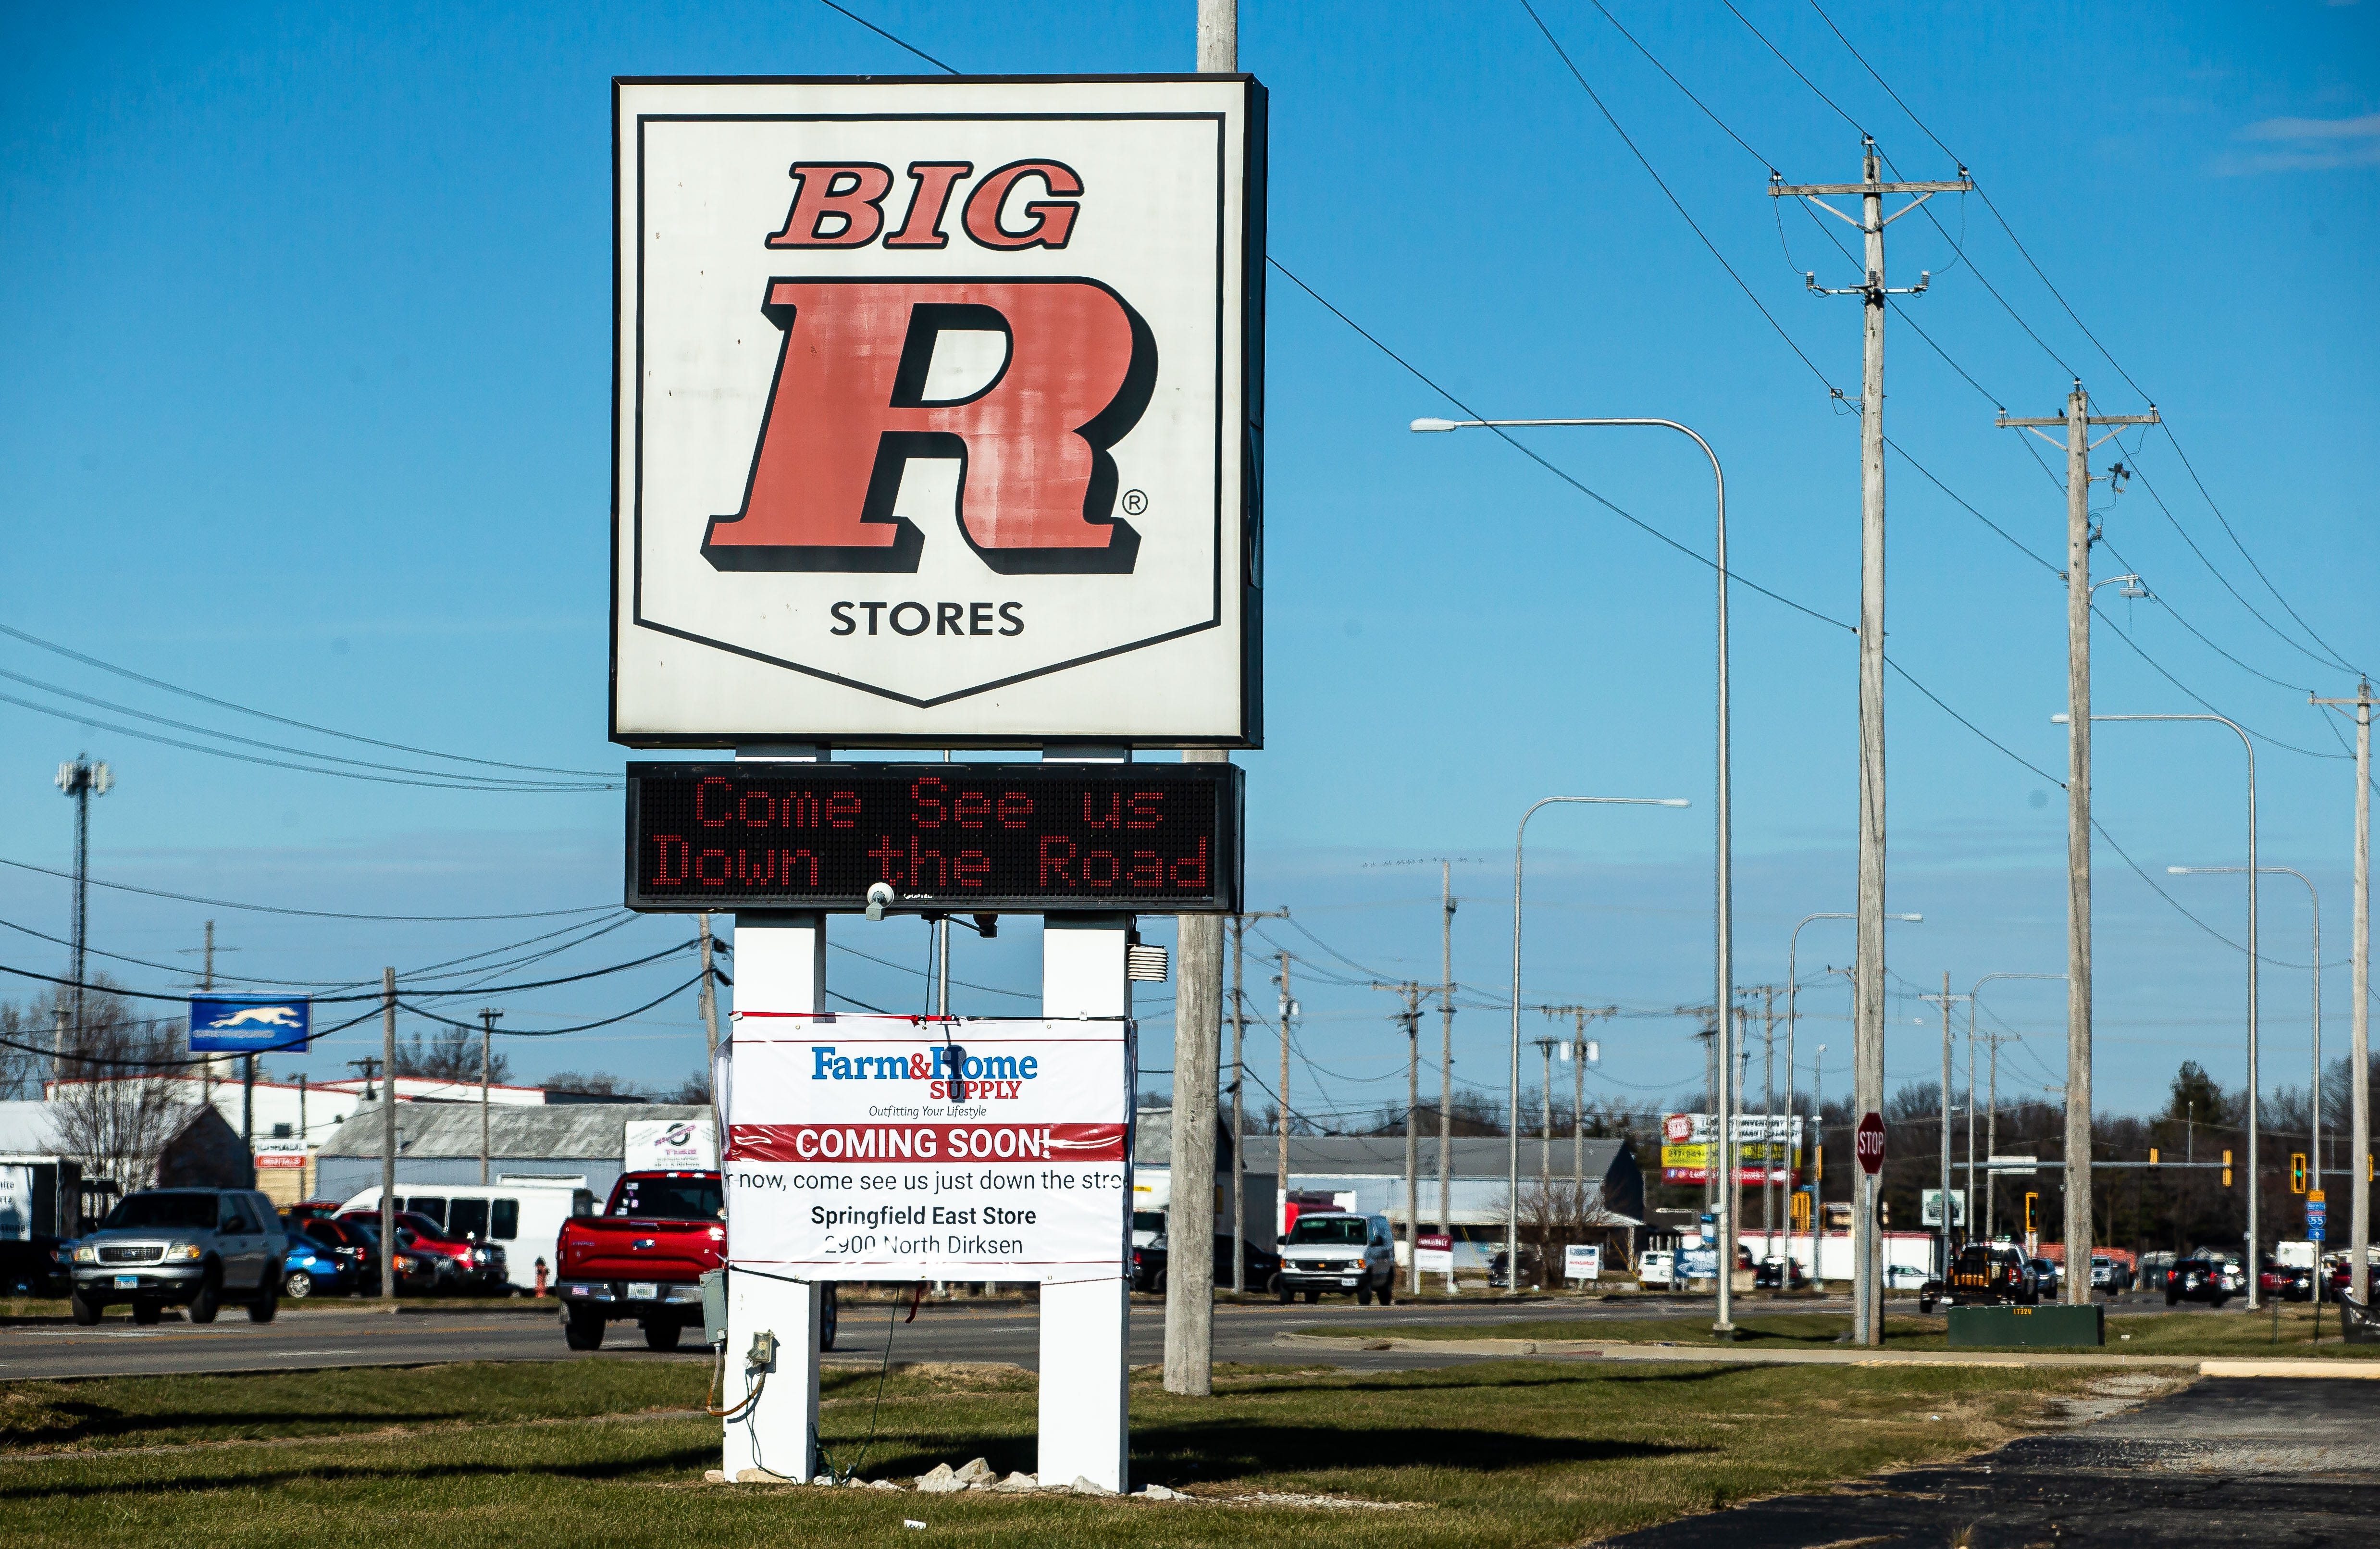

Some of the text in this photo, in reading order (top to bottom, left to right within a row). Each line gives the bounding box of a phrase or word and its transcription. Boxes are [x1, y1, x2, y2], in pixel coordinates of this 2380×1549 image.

[765, 159, 1085, 250] BIG
[700, 276, 1158, 575] R
[830, 602, 1024, 636] STORES
[697, 777, 1163, 829] Come See us
[652, 834, 1206, 887] Down the Road
[930, 1081, 1022, 1100] SUPPLY
[869, 1104, 987, 1119] Outfitting Your Lifestyle
[796, 1128, 1052, 1159] COMING SOON!
[1859, 1131, 1884, 1154] STOP
[740, 1174, 786, 1191] now,
[793, 1175, 853, 1190] come
[860, 1175, 896, 1190] see
[905, 1175, 928, 1190] us
[933, 1171, 973, 1195] just
[980, 1170, 1034, 1190] down
[1041, 1169, 1075, 1189] the
[811, 1205, 1036, 1229] Springfield East Store
[2310, 1216, 2323, 1225] 55
[884, 1235, 940, 1254] North
[948, 1235, 1023, 1254] Dirksen
